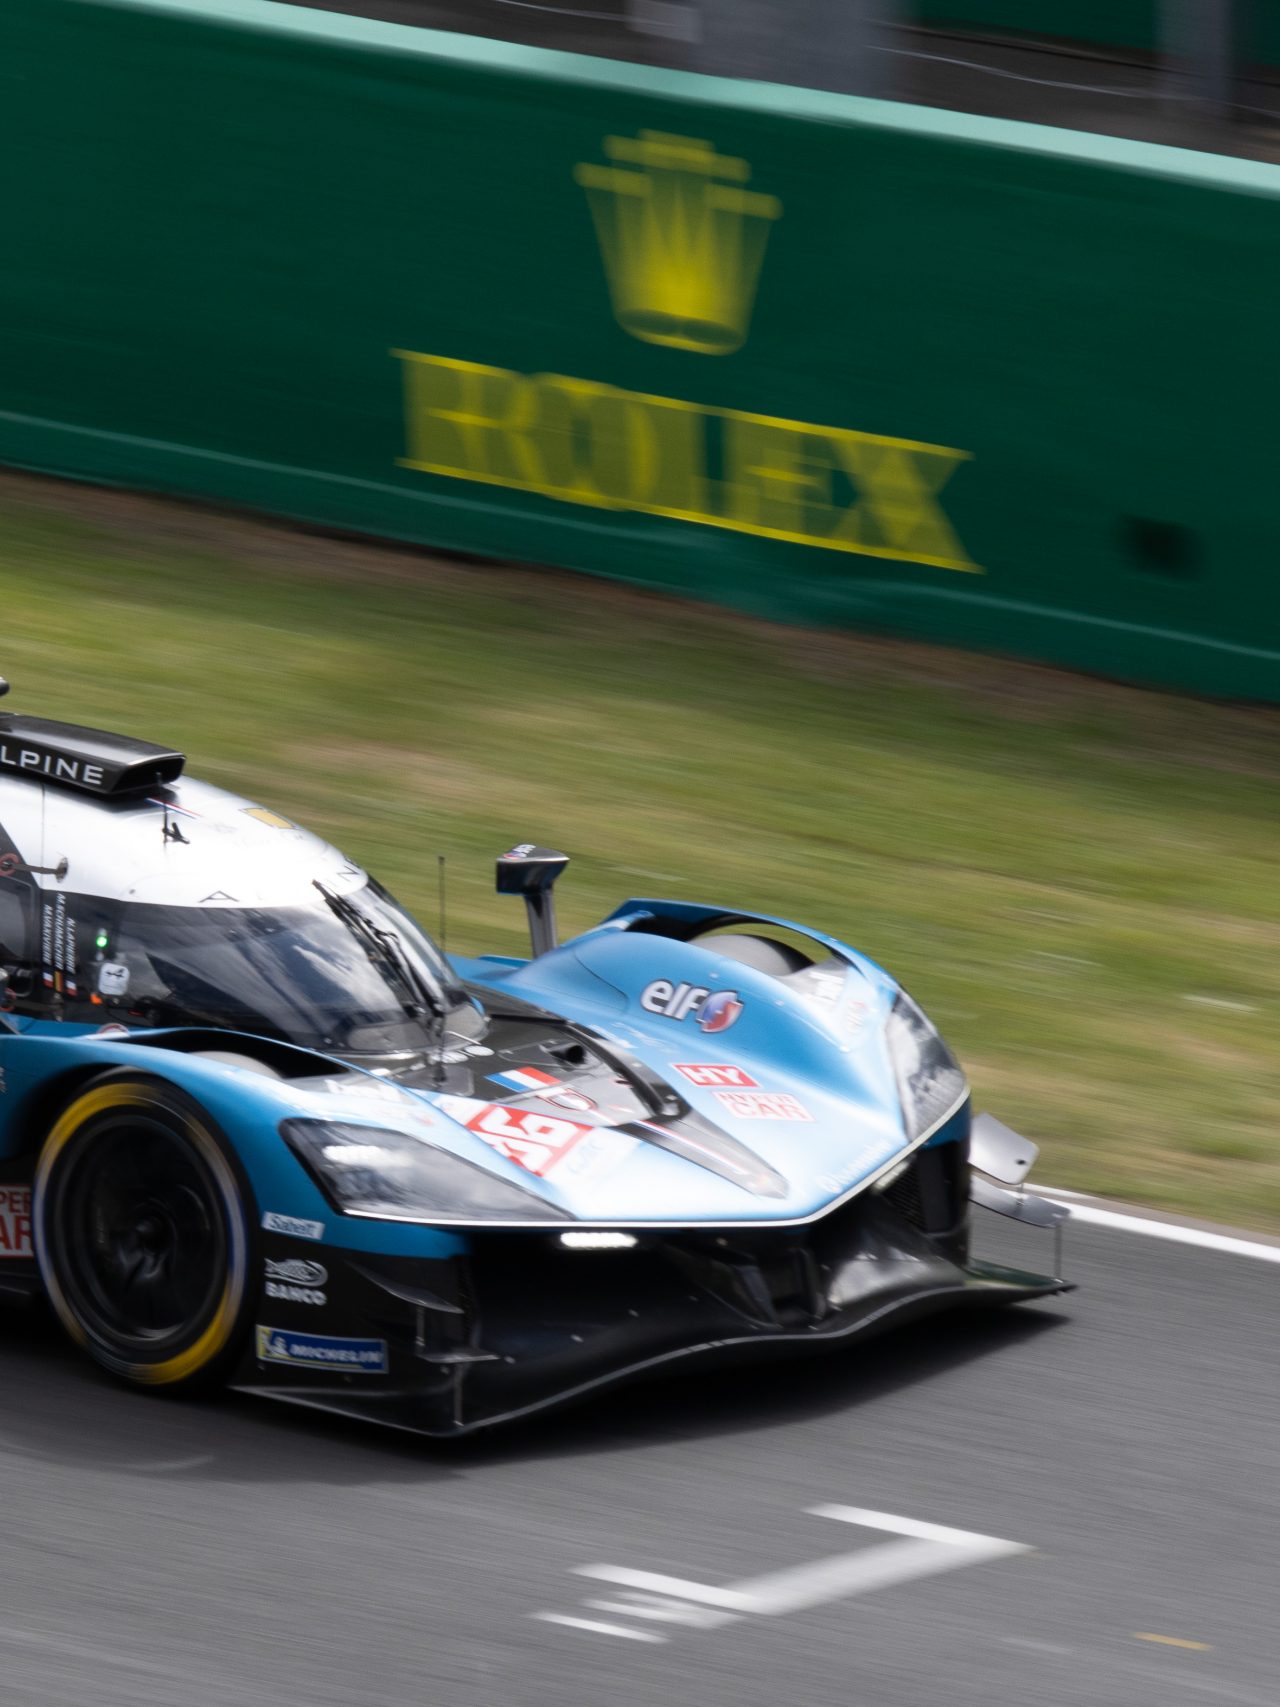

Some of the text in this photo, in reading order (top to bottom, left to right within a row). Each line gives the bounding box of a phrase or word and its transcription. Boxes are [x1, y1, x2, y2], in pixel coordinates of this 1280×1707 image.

[389, 347, 987, 575] ROLEX
[641, 979, 710, 1021] elf
[680, 1067, 744, 1085] HY
[731, 1103, 809, 1120] CAR
